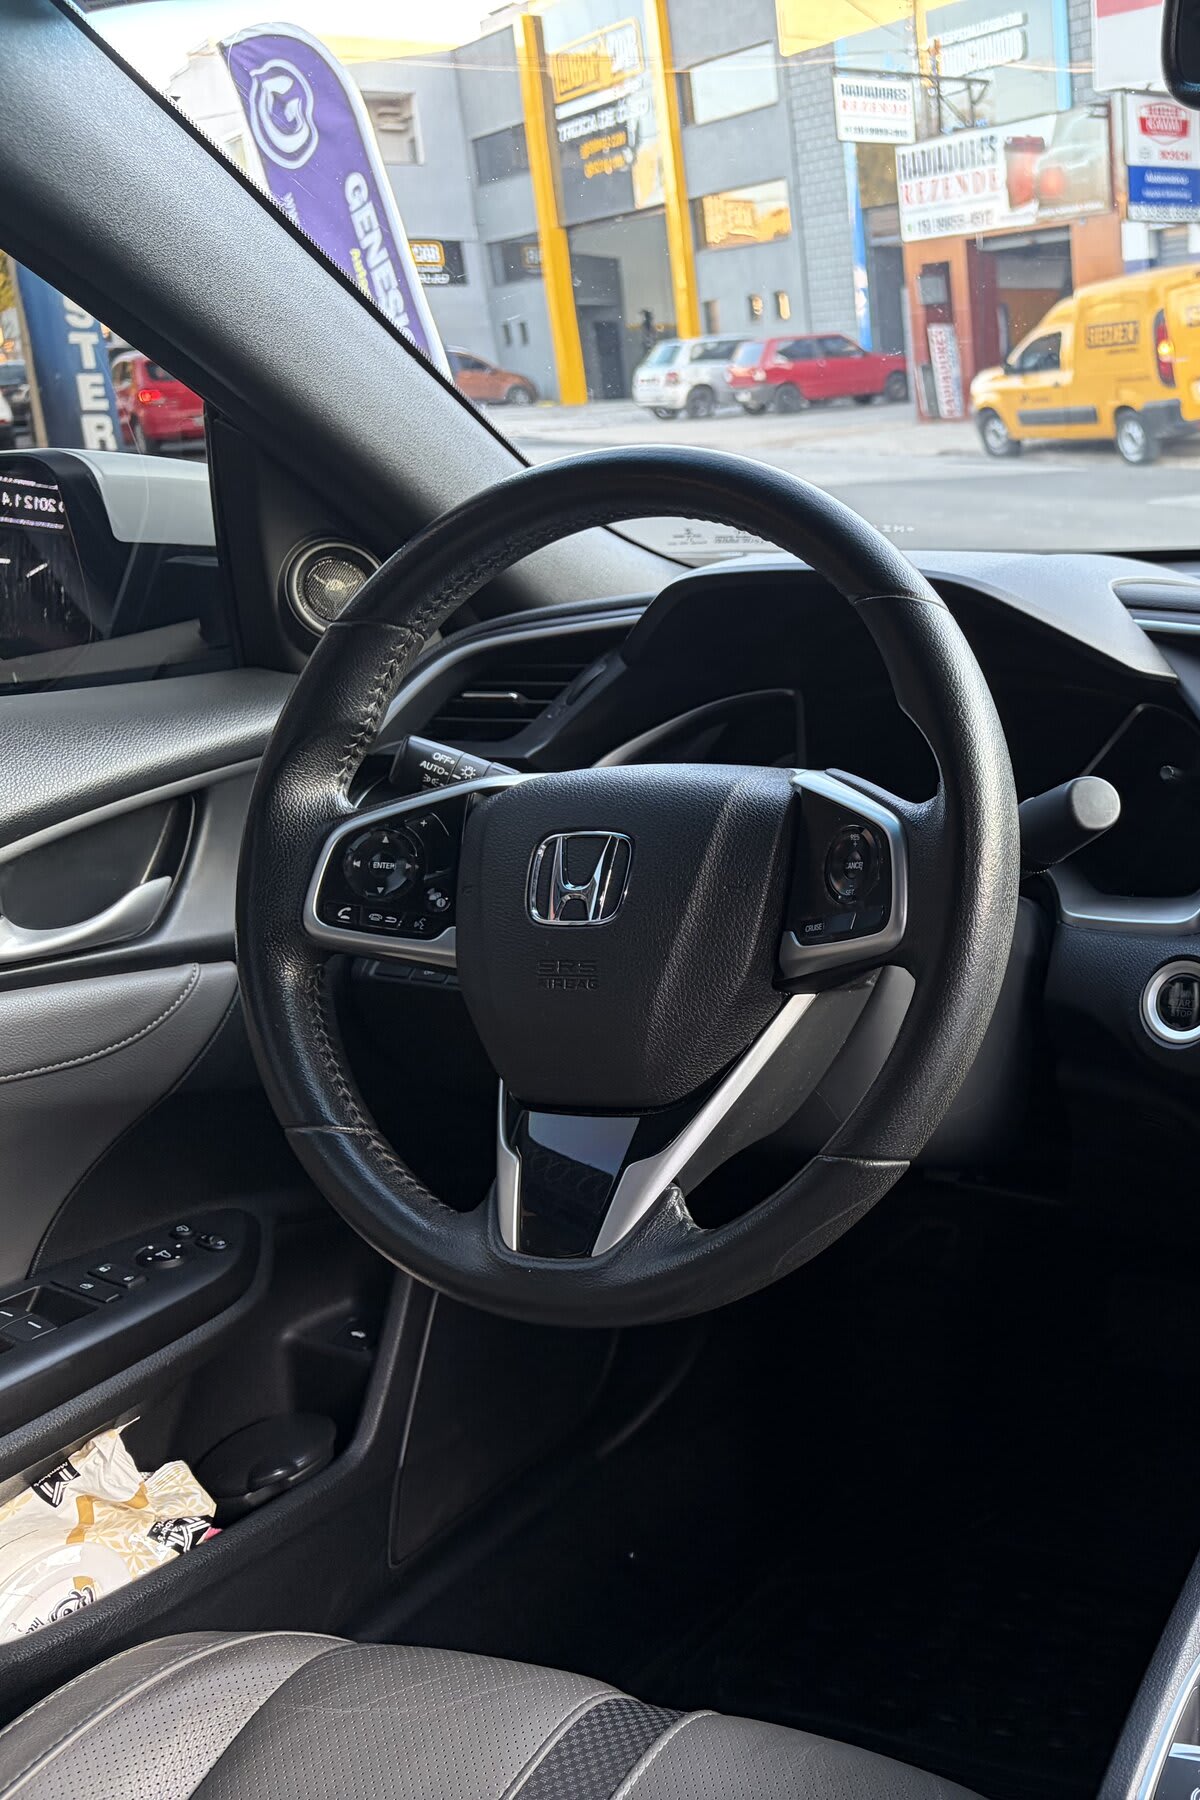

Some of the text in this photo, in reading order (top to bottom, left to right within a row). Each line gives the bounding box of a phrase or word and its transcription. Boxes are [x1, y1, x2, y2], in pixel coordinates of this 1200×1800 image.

[901, 168, 1000, 206] REZENDE
[432, 751, 452, 764] OFF
[419, 760, 446, 775] AUTO
[372, 861, 396, 870] ENTER
[804, 922, 823, 933] CRUISE
